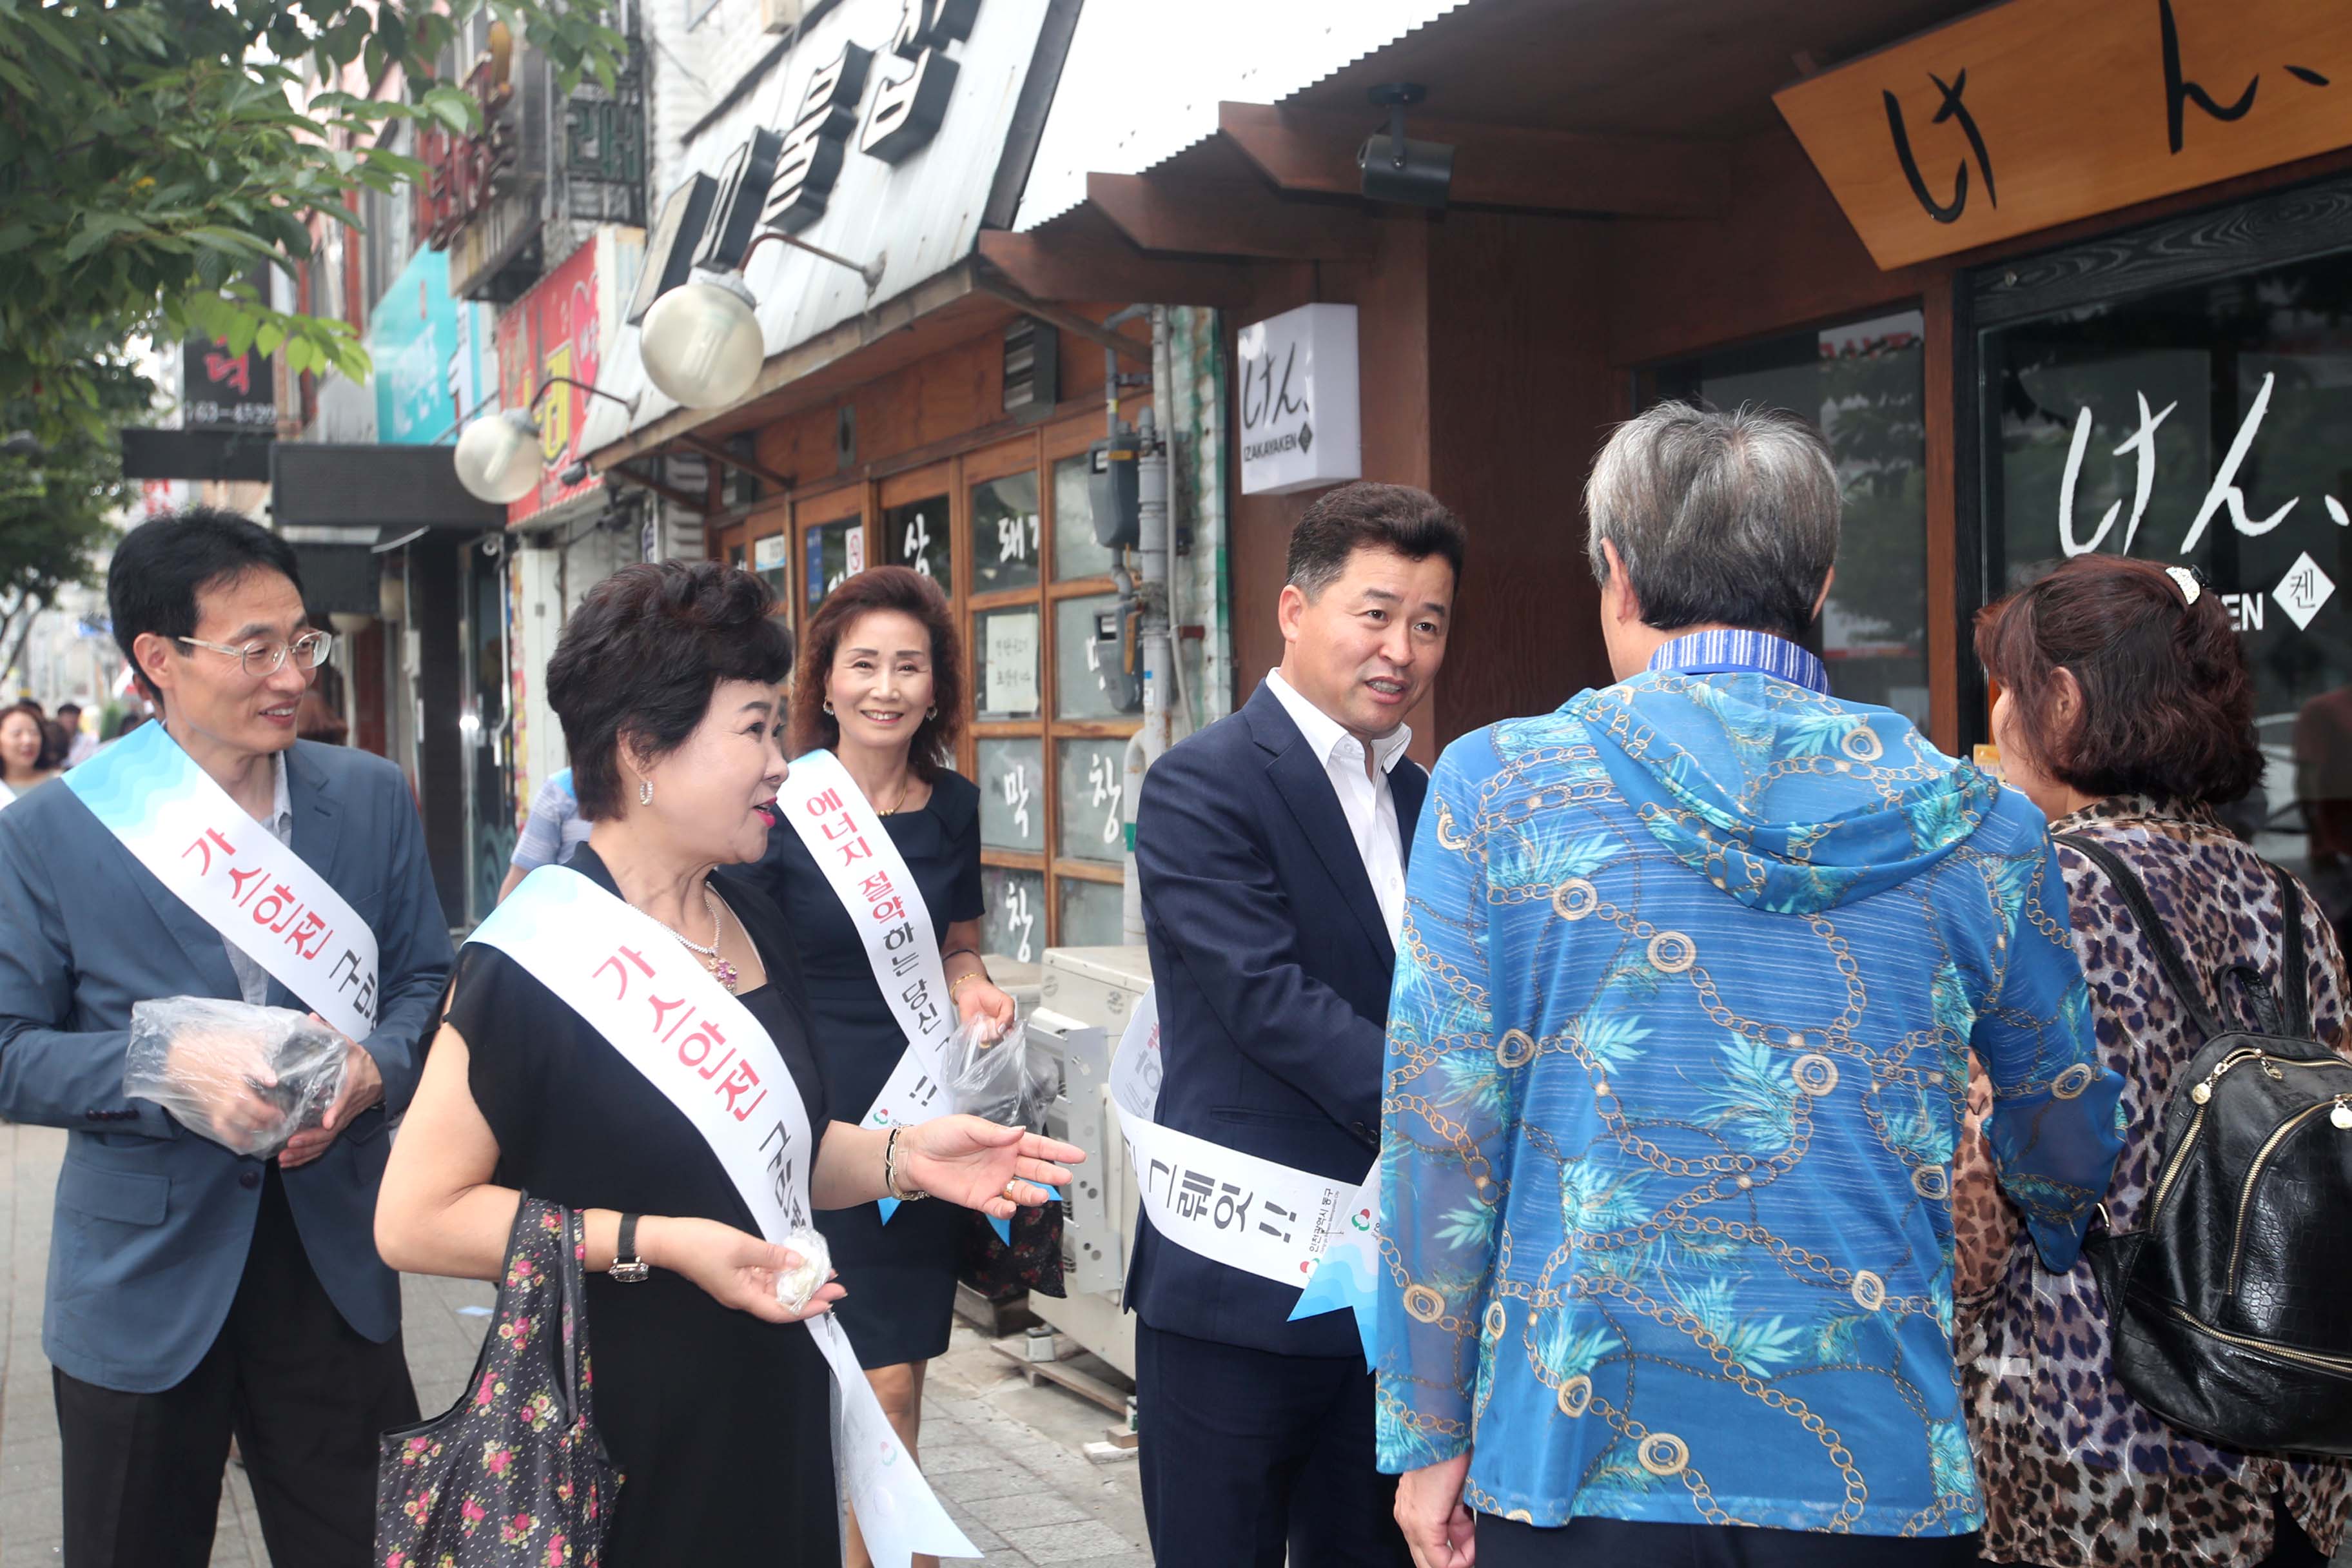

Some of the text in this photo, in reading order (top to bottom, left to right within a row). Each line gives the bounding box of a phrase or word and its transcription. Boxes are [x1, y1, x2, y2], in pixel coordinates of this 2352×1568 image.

[1244, 433, 1297, 462] IZAKAYAKEN
[2291, 568, 2317, 609] 켄
[181, 827, 334, 961] 가스안전
[806, 787, 942, 1035] 에너지 절약하는 당신
[591, 945, 769, 1122] 가스안전
[1309, 1188, 1334, 1253] 인천광역시 동구
